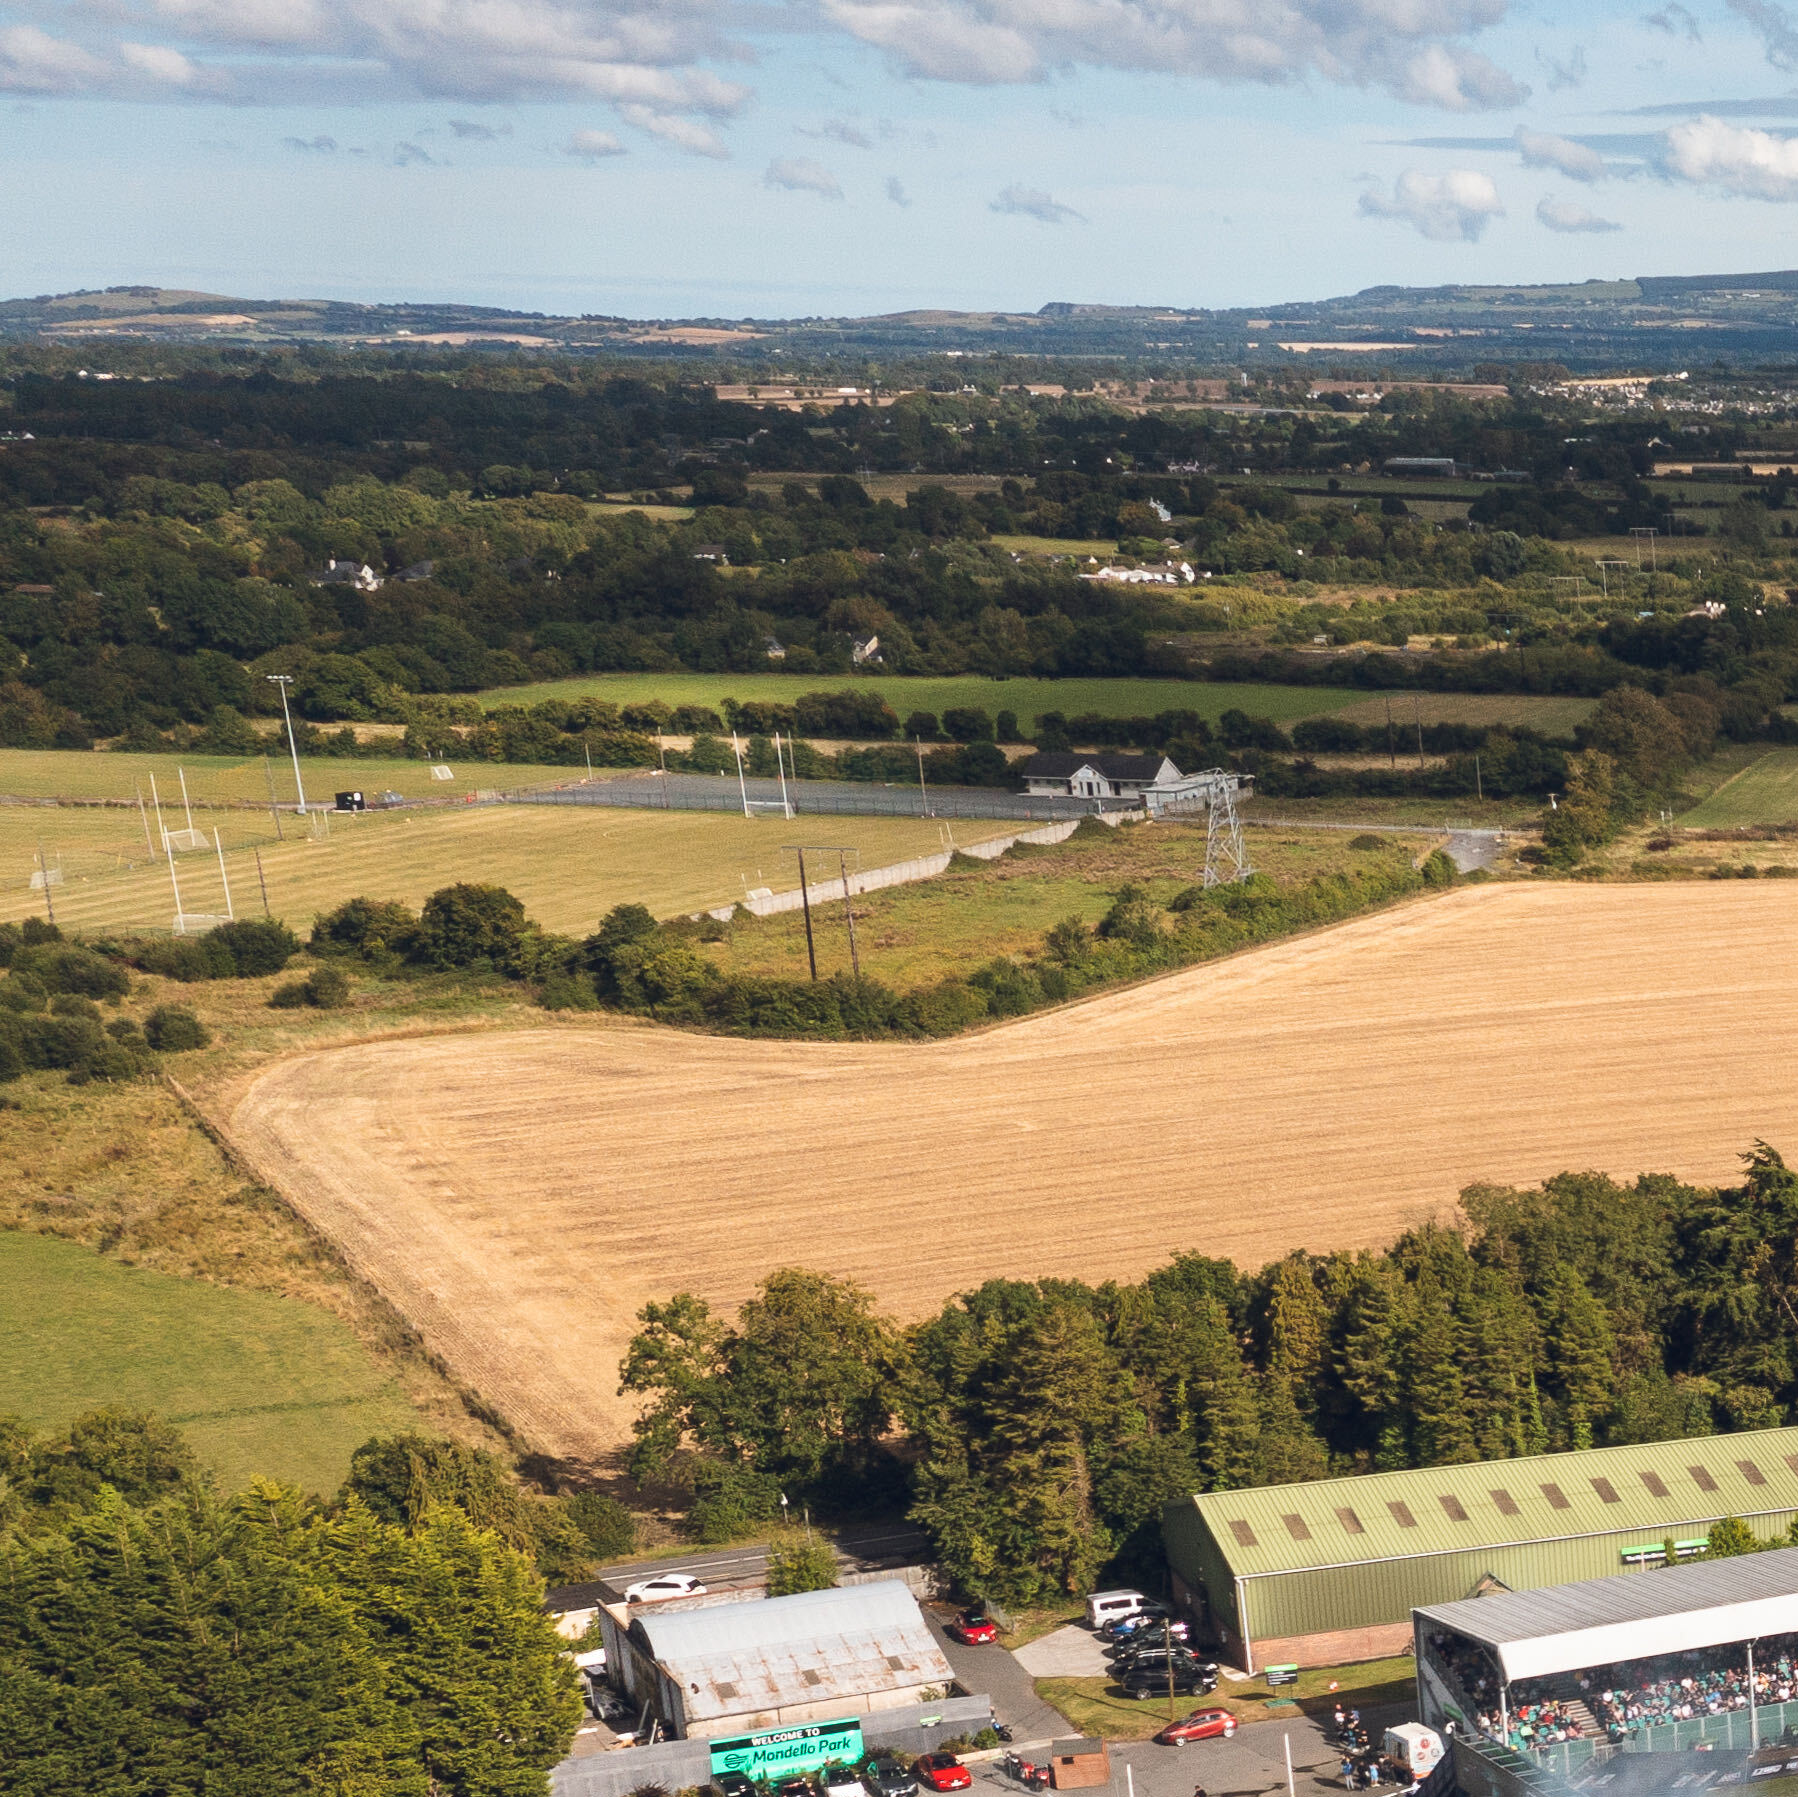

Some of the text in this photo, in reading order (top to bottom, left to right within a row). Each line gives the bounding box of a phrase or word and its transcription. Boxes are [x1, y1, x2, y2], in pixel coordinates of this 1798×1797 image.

[751, 1727, 820, 1746] WELCOME TO
[753, 1737, 851, 1763] Mondello Park
